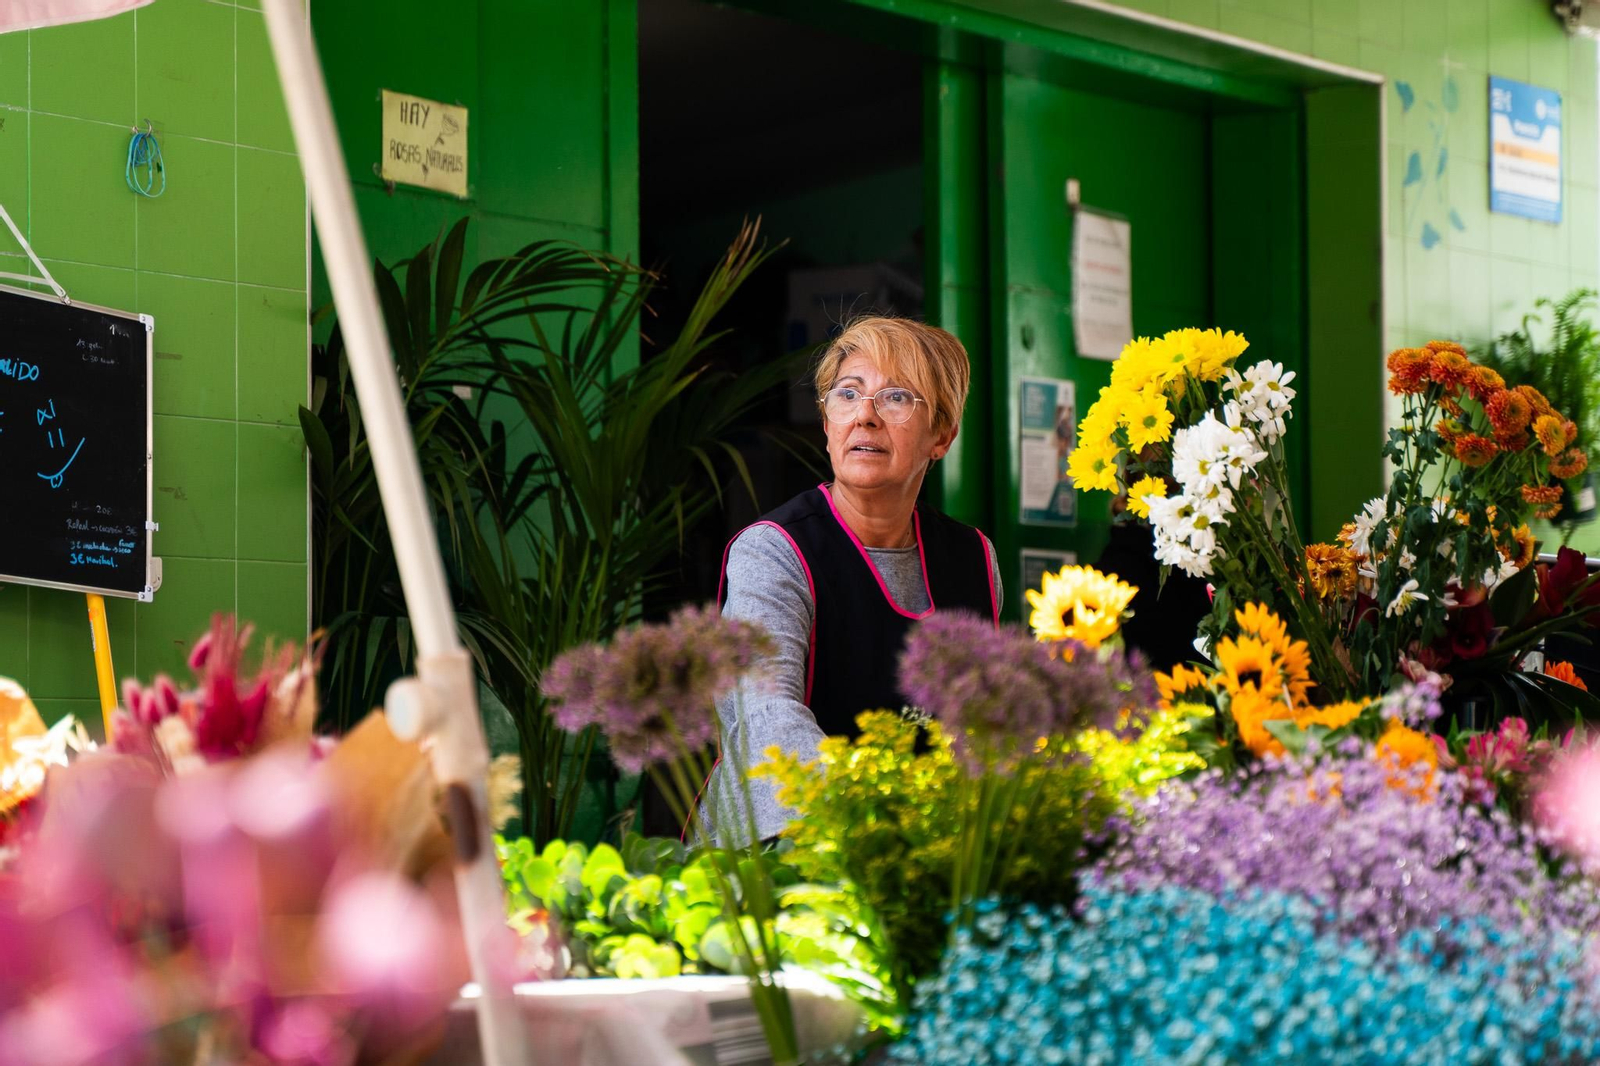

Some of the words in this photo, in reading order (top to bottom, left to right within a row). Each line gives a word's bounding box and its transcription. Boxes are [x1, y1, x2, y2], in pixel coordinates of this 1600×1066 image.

[400, 101, 430, 129] HAY
[389, 138, 422, 164] ROSAS
[70, 553, 85, 565] 3€
